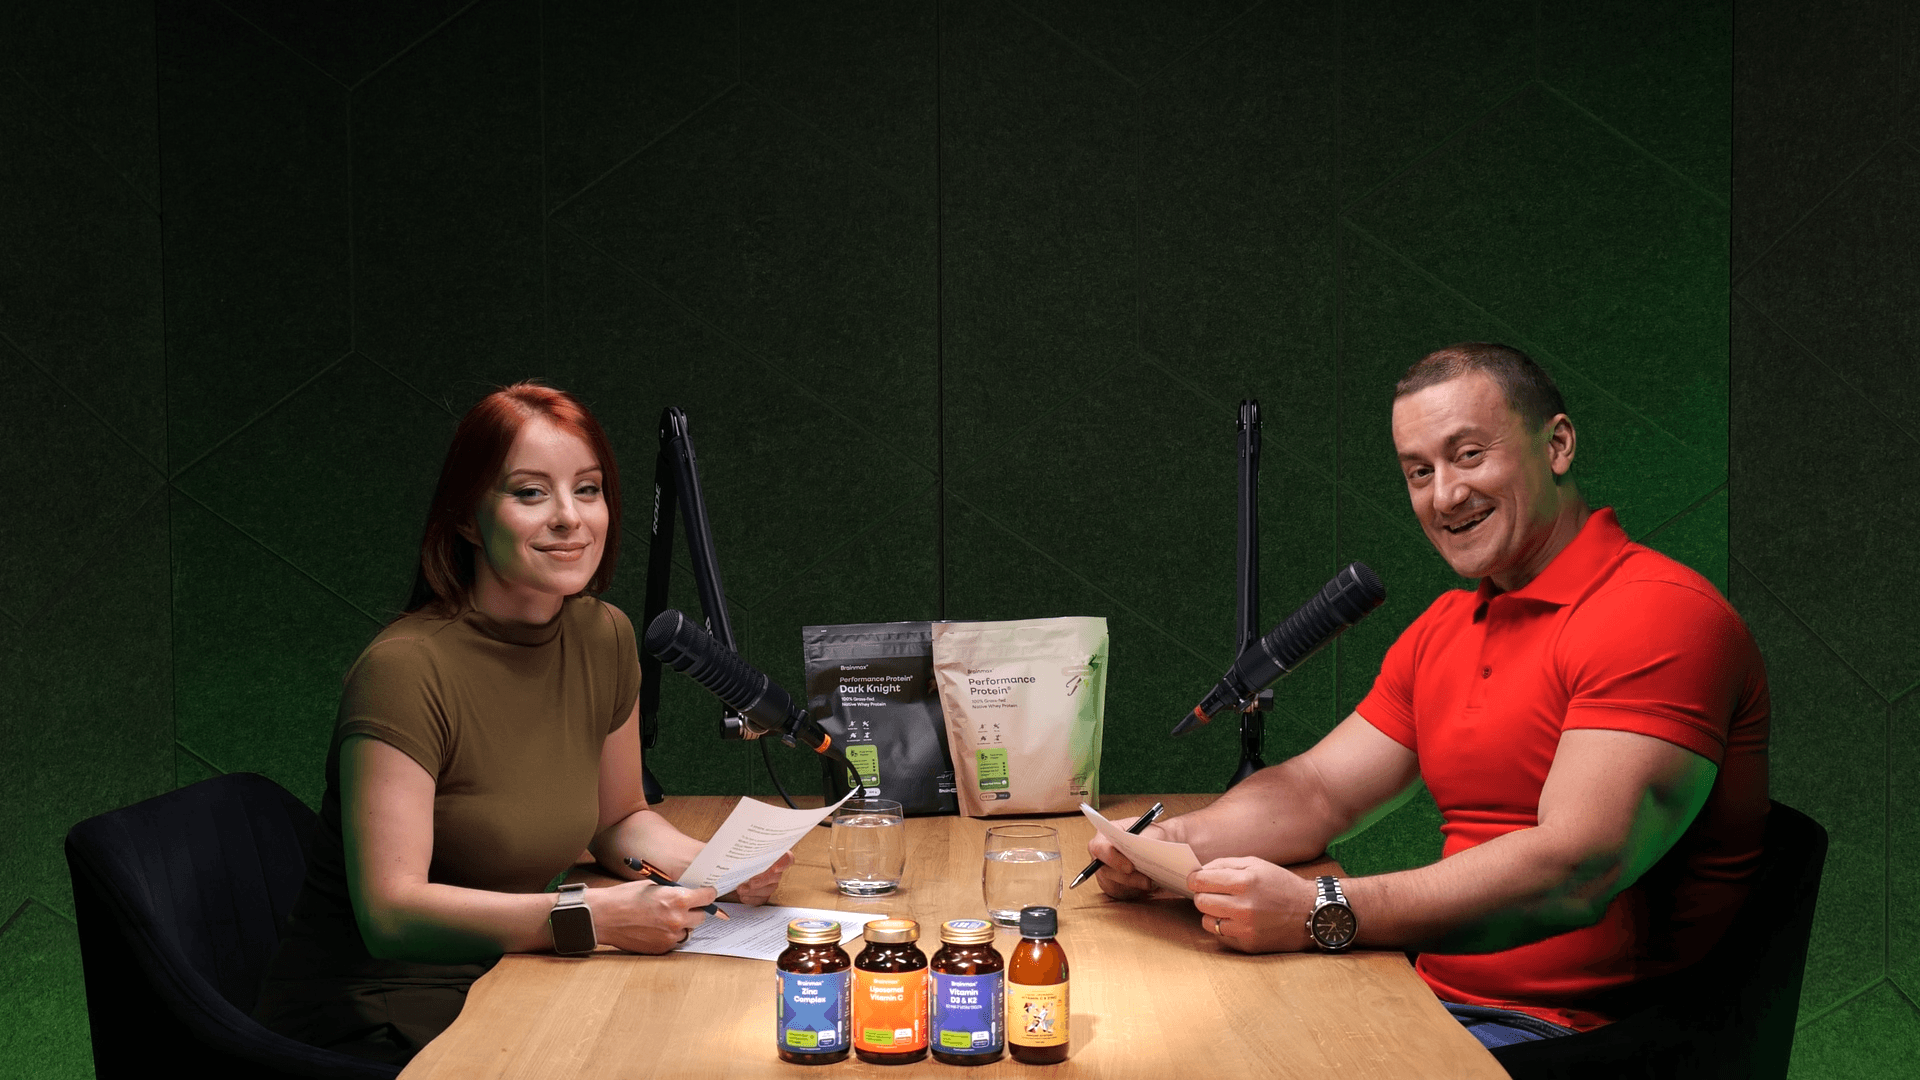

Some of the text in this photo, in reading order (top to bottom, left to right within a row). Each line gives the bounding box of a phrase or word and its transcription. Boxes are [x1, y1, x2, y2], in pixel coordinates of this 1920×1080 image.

[968, 676, 1036, 686] Performance
[840, 683, 901, 695] Dark Knight
[801, 987, 819, 995] Zinc
[869, 985, 904, 994] Liposomal
[949, 987, 979, 996] Vitamin
[793, 995, 827, 1004] Complex
[869, 993, 897, 1001] Vitamin
[950, 996, 961, 1004] D3
